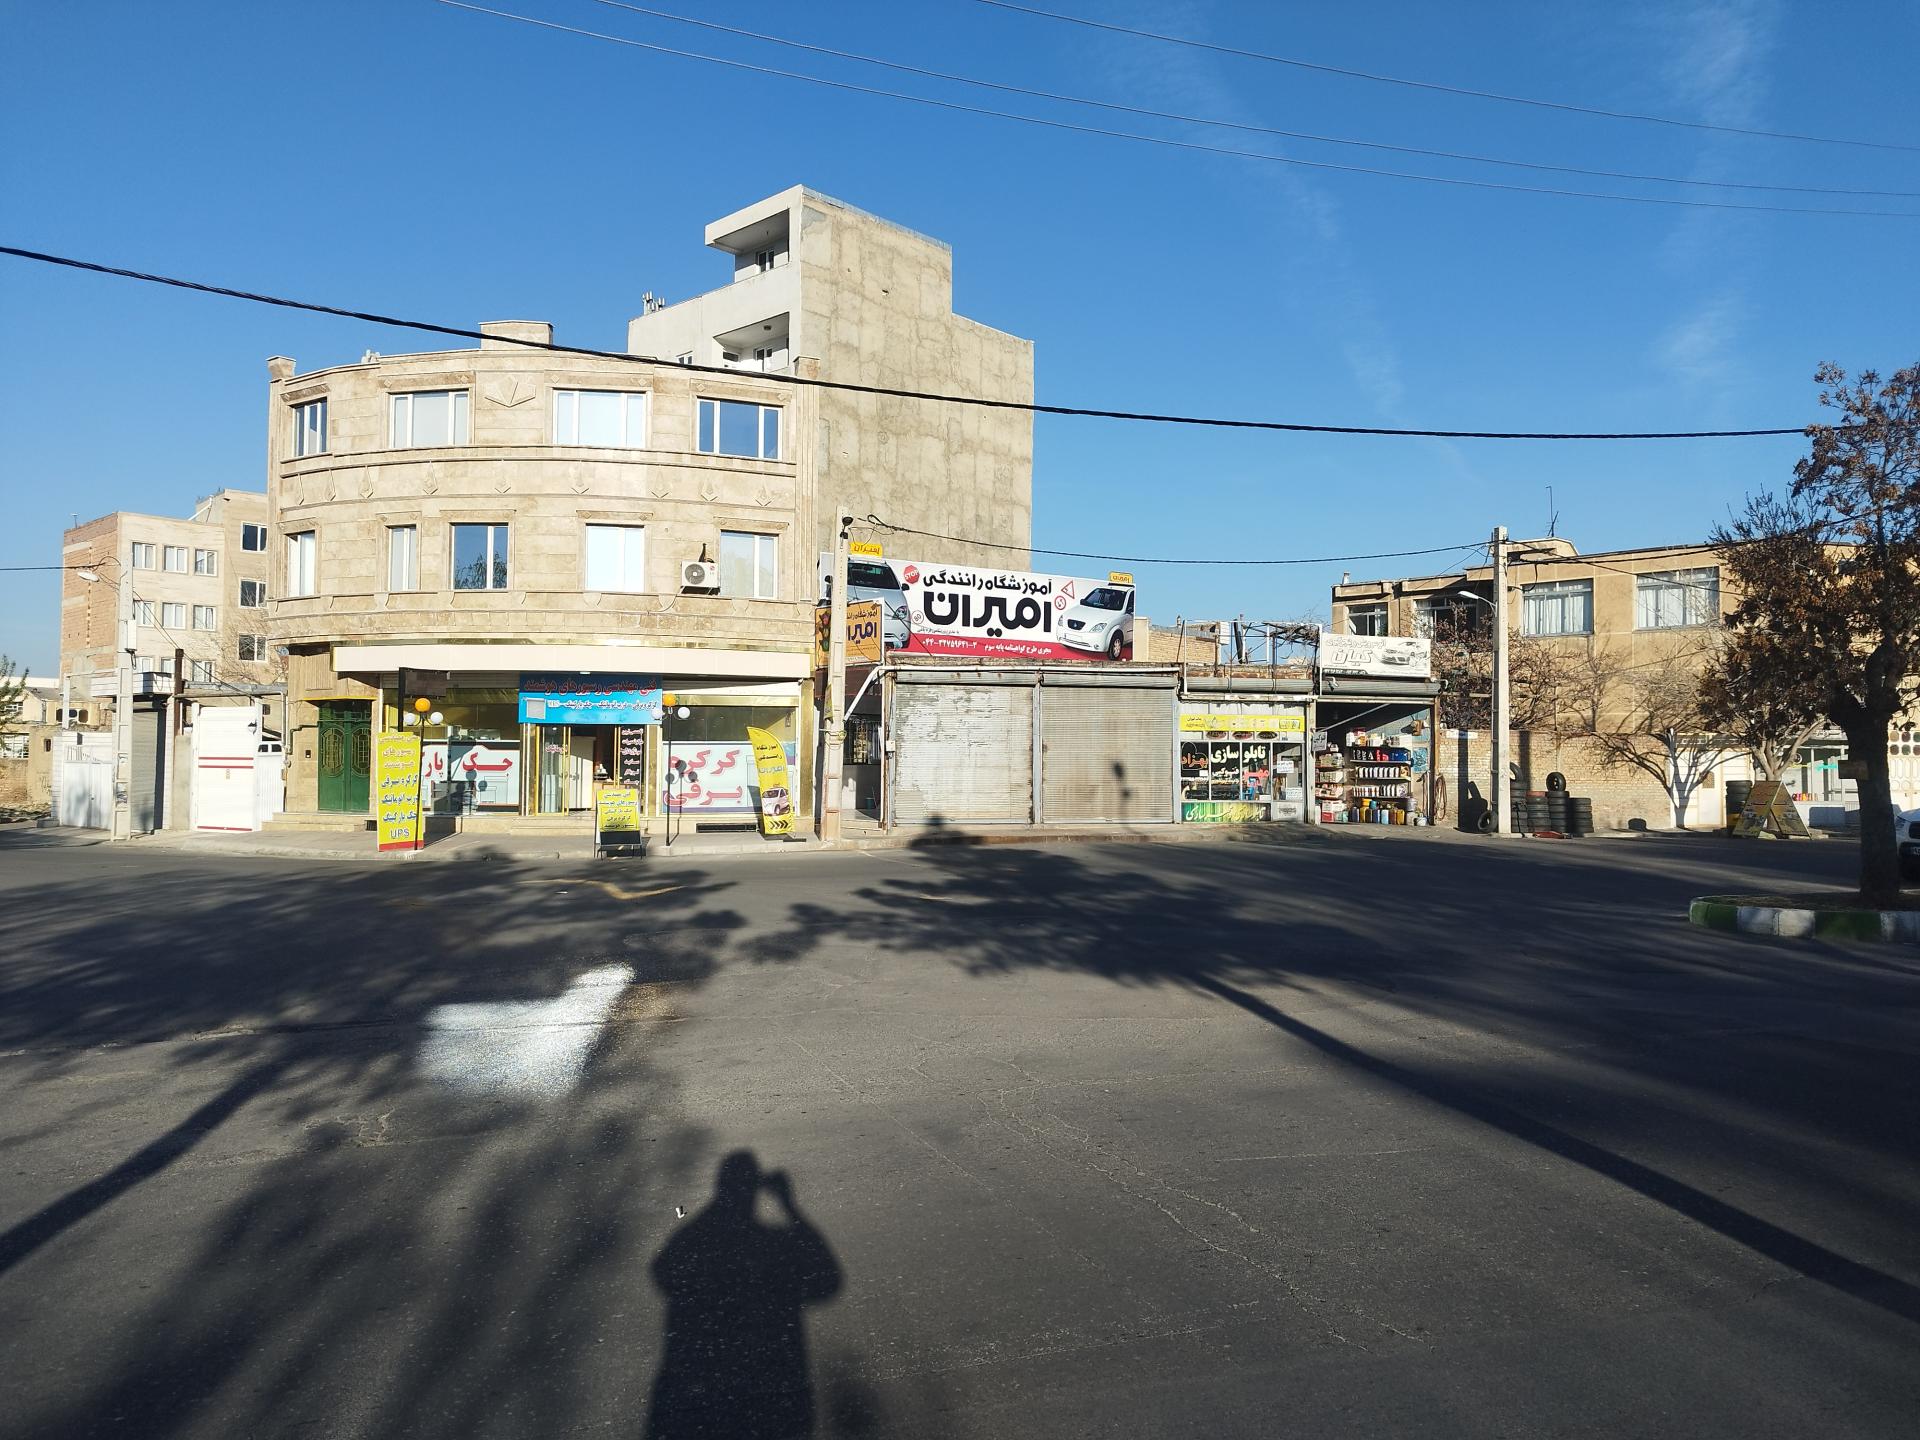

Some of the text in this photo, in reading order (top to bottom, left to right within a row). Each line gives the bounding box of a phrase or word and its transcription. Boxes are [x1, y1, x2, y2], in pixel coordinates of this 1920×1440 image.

[904, 569, 920, 579] STOP
[923, 569, 1053, 595] آموزشگاه رانندگی
[923, 591, 1052, 637] امیران
[847, 621, 877, 645] امیرا
[1332, 649, 1373, 666] کیان
[1210, 745, 1267, 763] تابلو سازی
[663, 783, 743, 807] برقی
[390, 828, 410, 839] UPS
